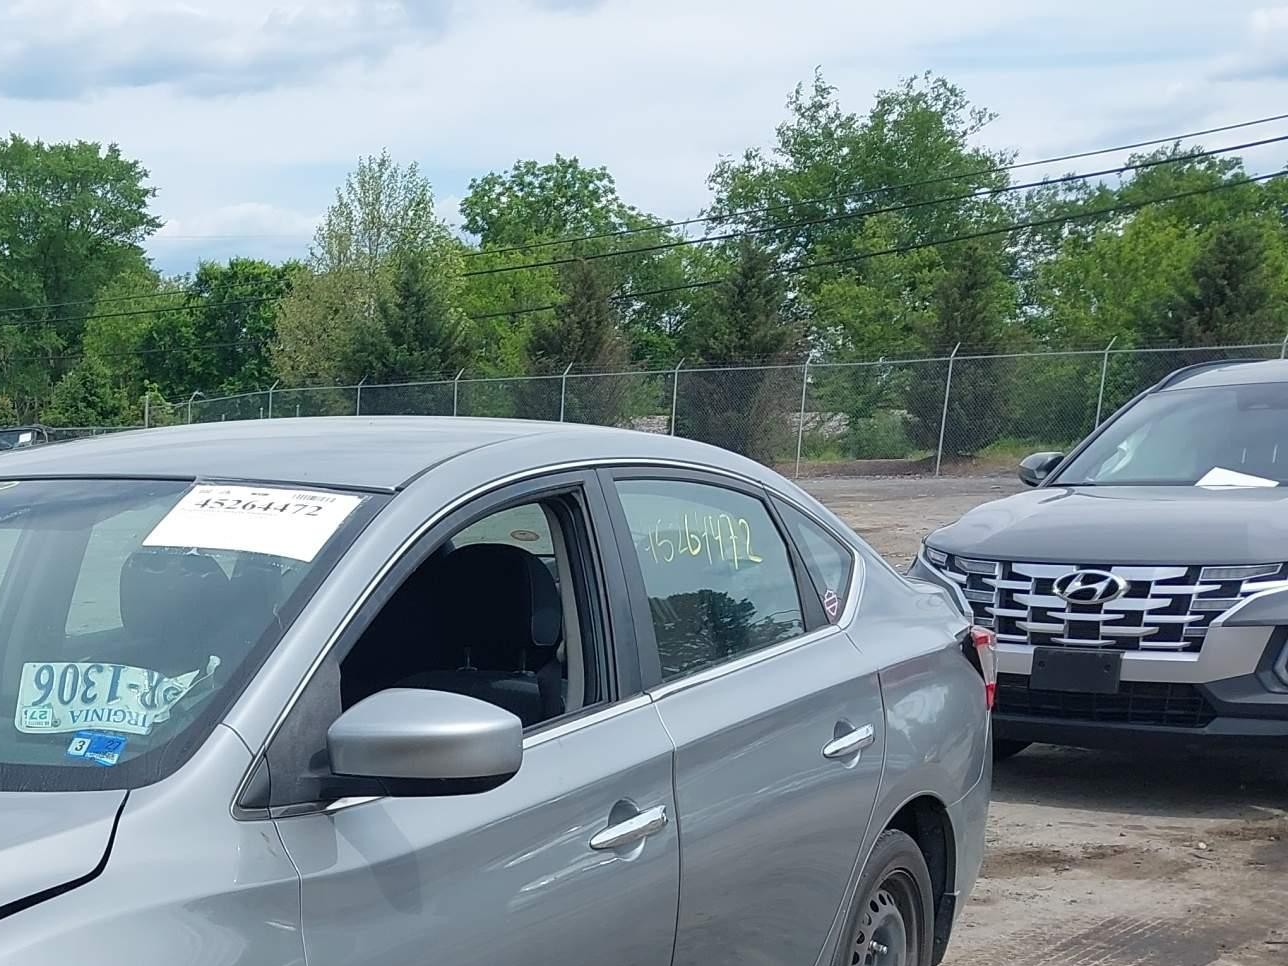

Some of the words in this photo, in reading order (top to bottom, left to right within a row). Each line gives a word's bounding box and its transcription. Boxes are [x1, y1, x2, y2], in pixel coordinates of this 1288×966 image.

[195, 498, 323, 517] 45264472
[69, 708, 148, 728] IRGINIA
[75, 740, 86, 752] 3
